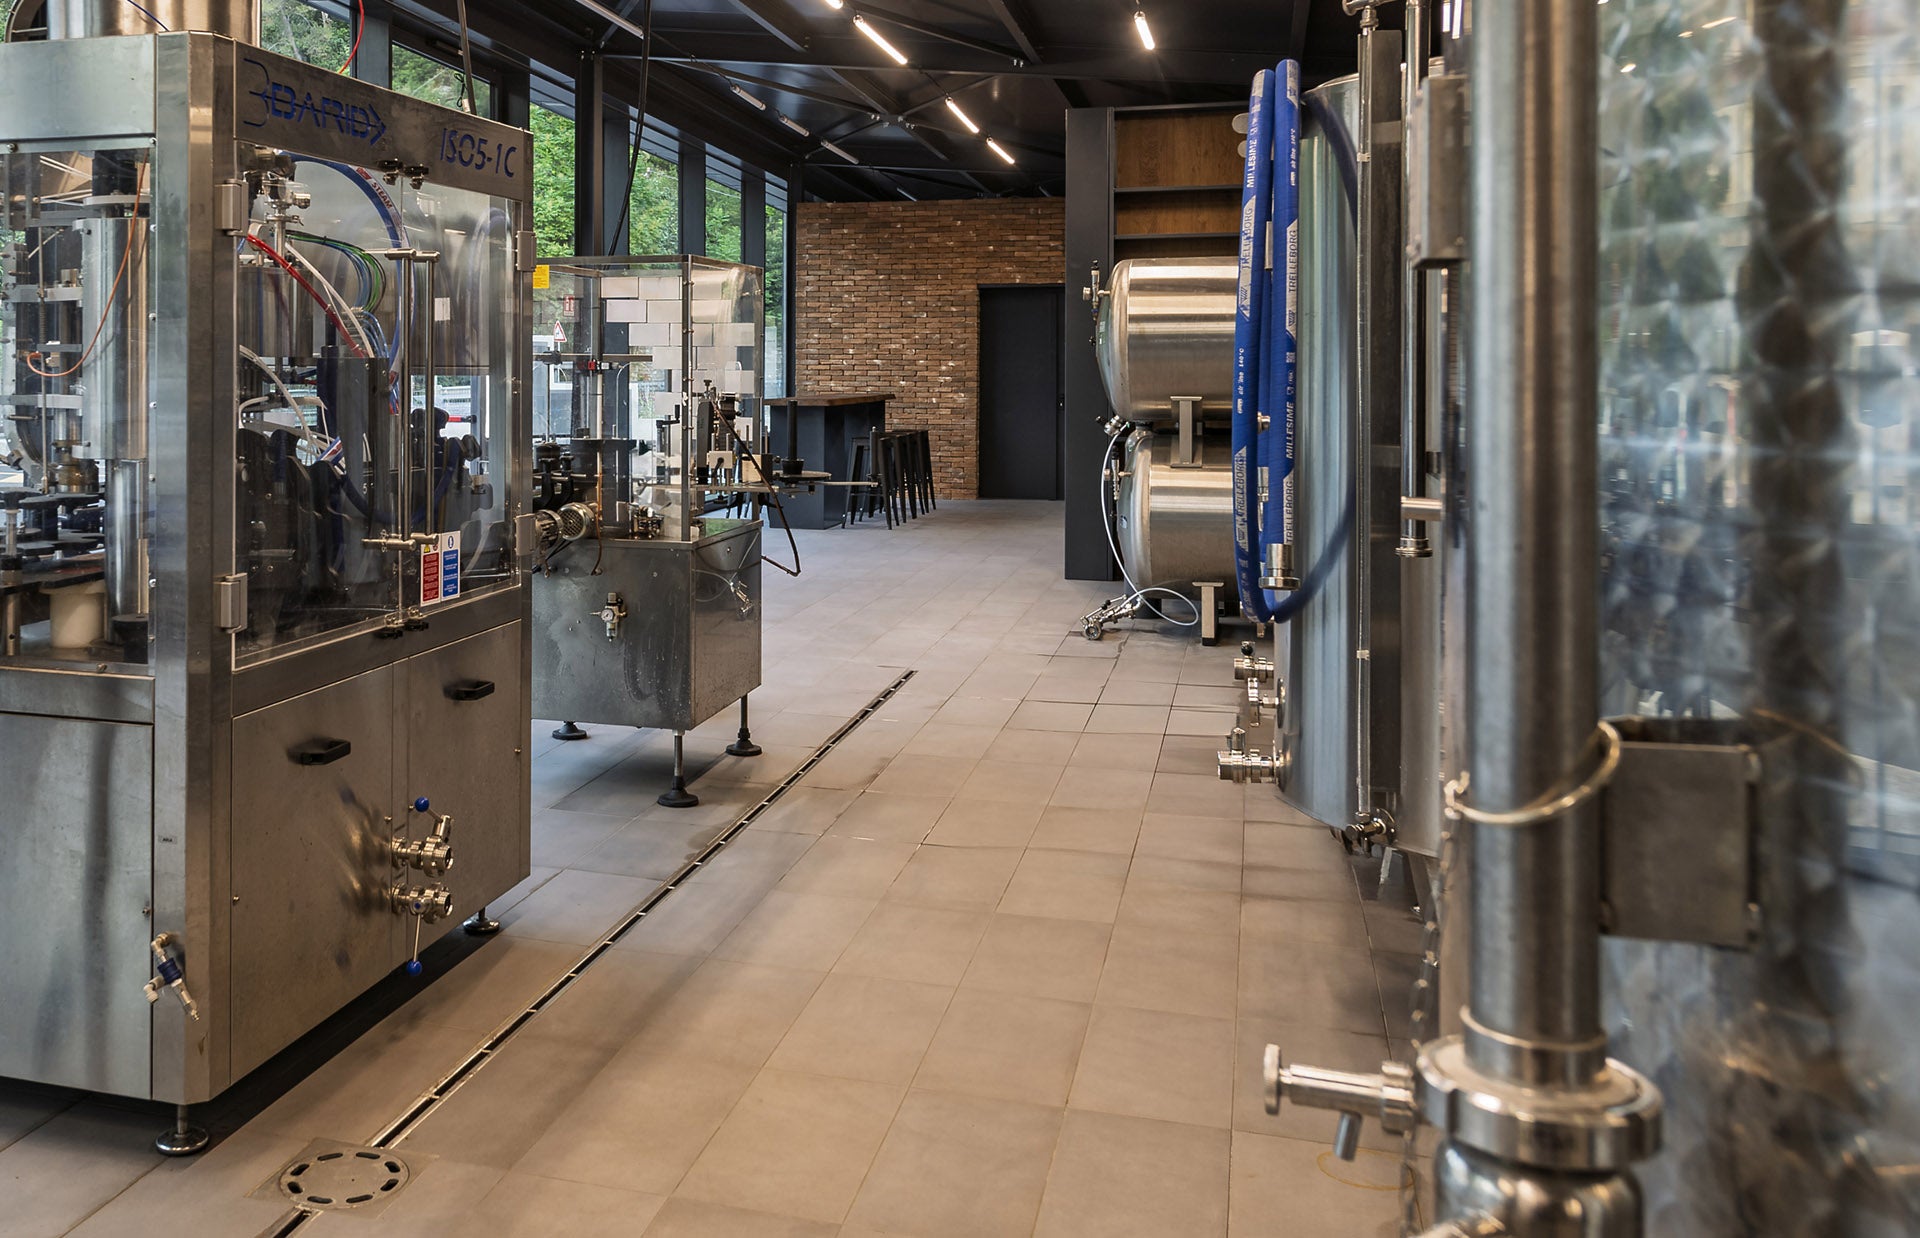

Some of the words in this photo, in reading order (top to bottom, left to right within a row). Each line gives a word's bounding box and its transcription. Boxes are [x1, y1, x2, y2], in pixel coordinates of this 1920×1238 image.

[371, 182, 393, 209] STEAM
[1240, 208, 1253, 270] TRELLBORG
[1288, 230, 1297, 293] TRELLEBORG
[1285, 401, 1294, 459] MILLESIME
[1285, 481, 1293, 543] TRELLEBORG
